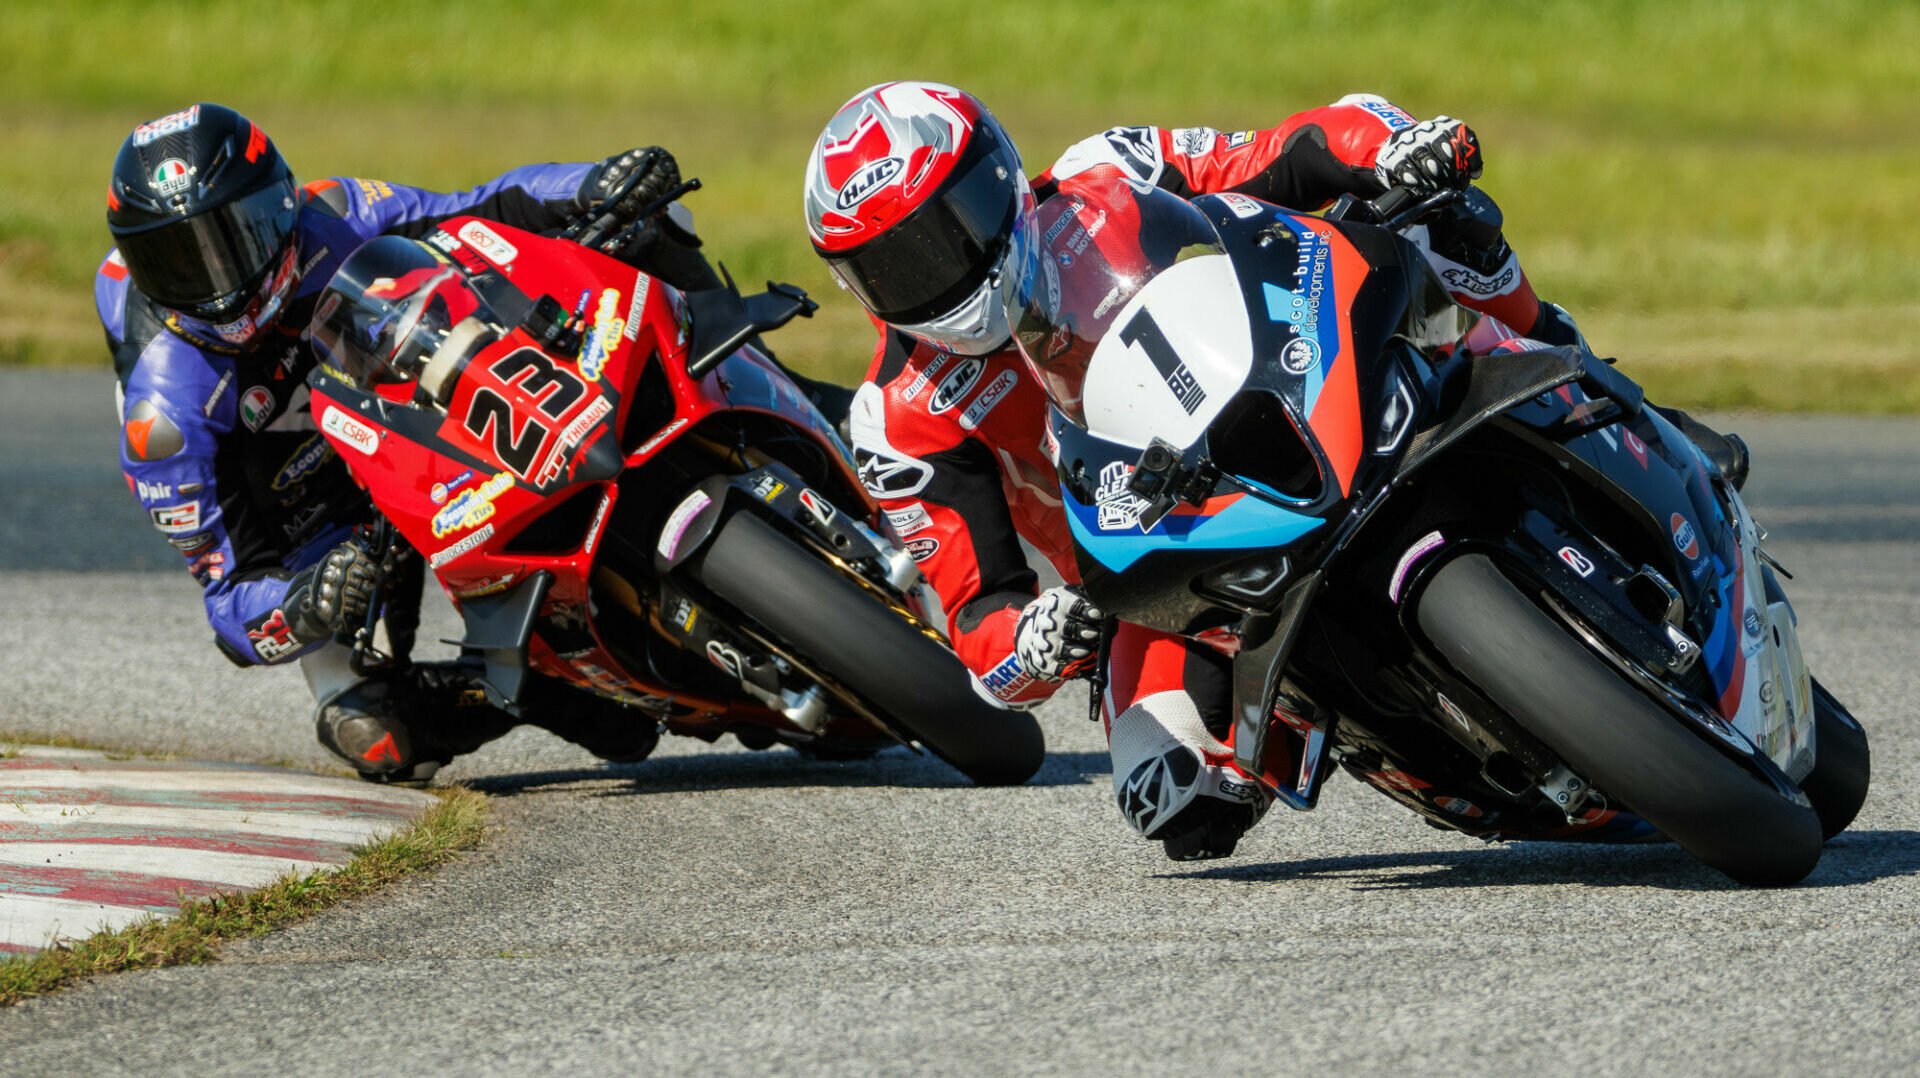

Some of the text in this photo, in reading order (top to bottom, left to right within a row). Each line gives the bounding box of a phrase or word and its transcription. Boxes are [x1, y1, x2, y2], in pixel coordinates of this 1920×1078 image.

[843, 159, 894, 205] HJC
[1289, 230, 1316, 334] scot-build
[1303, 230, 1332, 333] developments inc
[938, 359, 979, 407] HJC
[980, 372, 1011, 408] CSBK
[343, 421, 373, 446] CSBK
[463, 345, 588, 479] 23
[566, 399, 610, 444] THIBAULT
[472, 505, 493, 521] Tire
[904, 521, 925, 534] POWER
